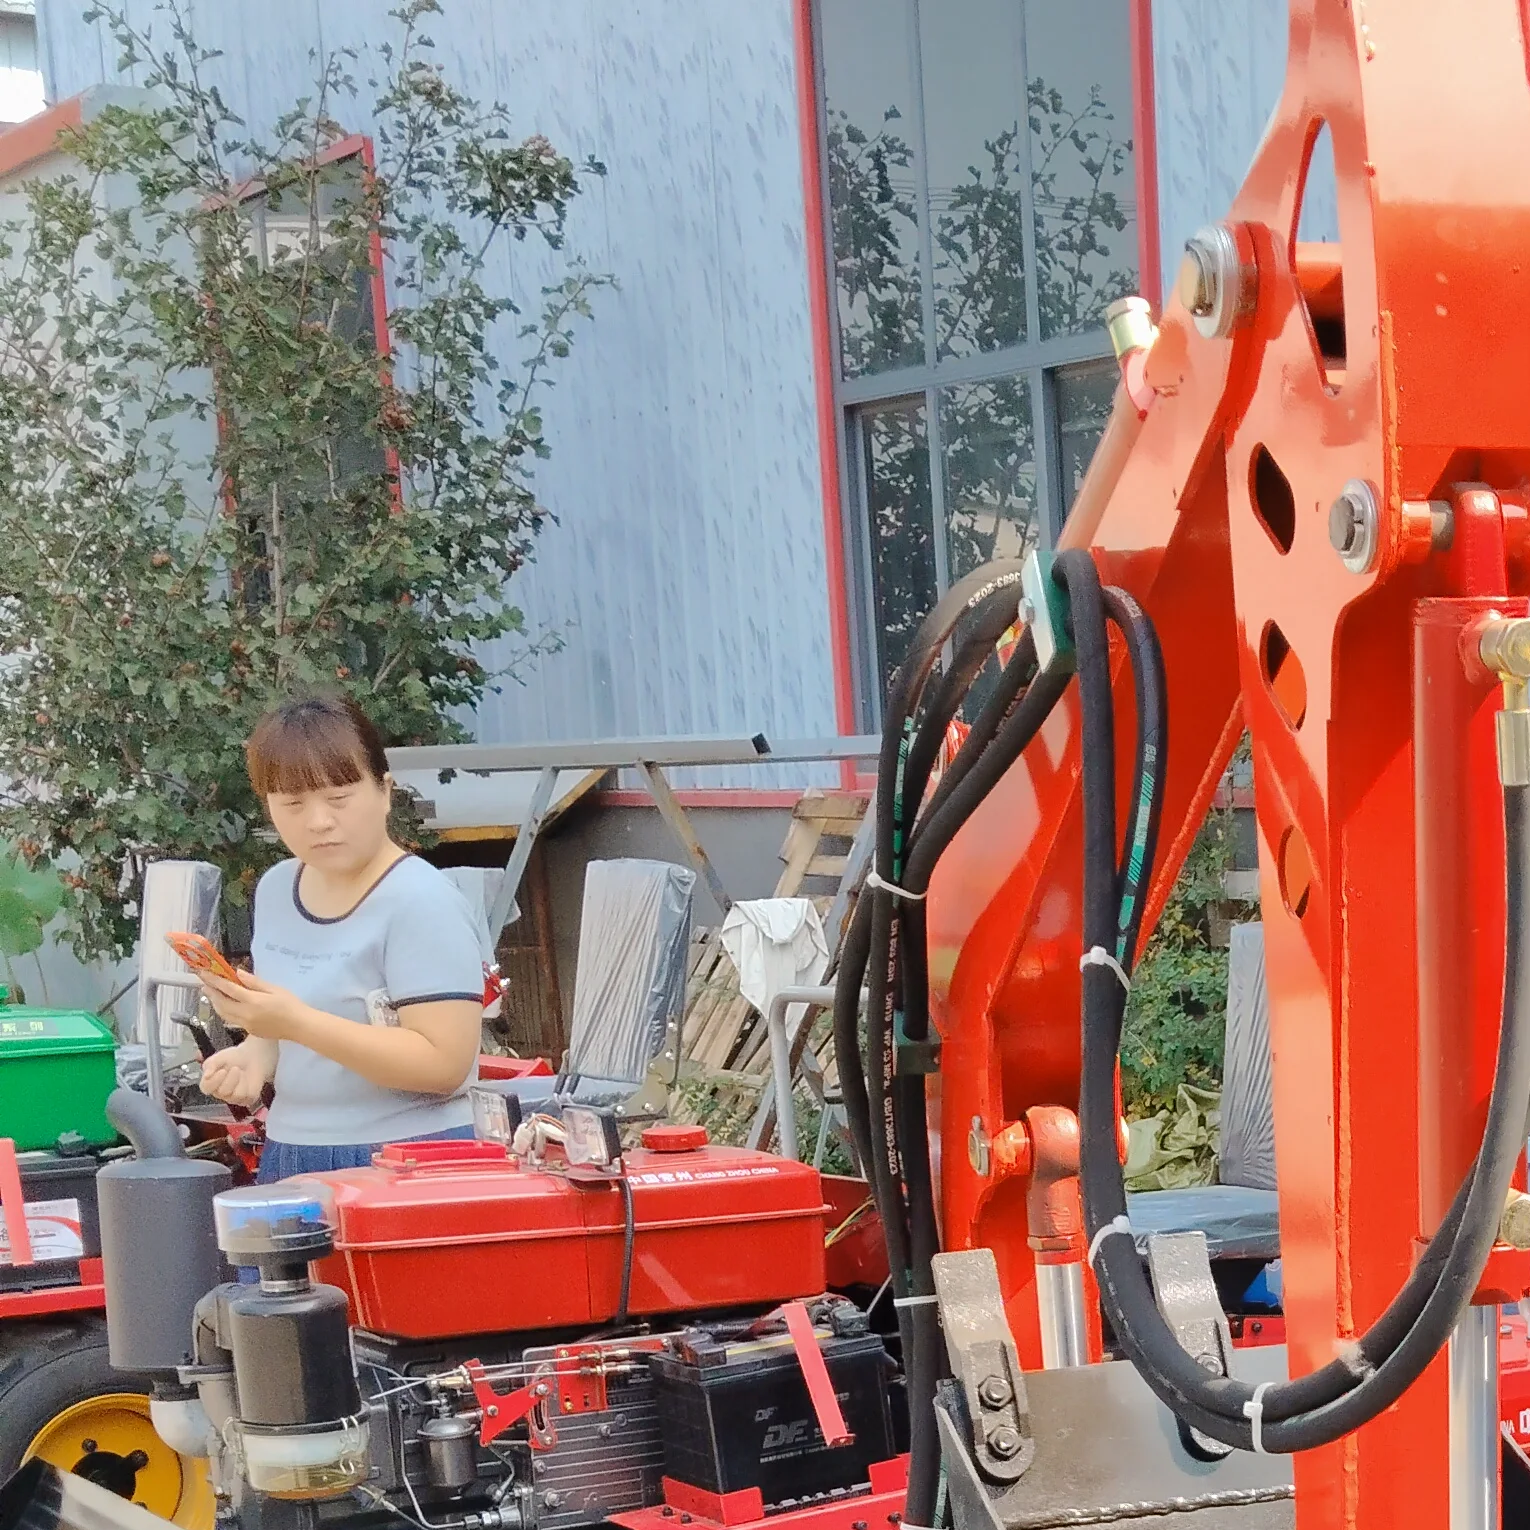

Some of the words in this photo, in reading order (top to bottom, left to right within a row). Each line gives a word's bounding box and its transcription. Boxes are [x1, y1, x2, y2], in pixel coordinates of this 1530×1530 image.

[967, 572, 1022, 608] 3683-2023
[627, 1170, 694, 1185] 中国常州
